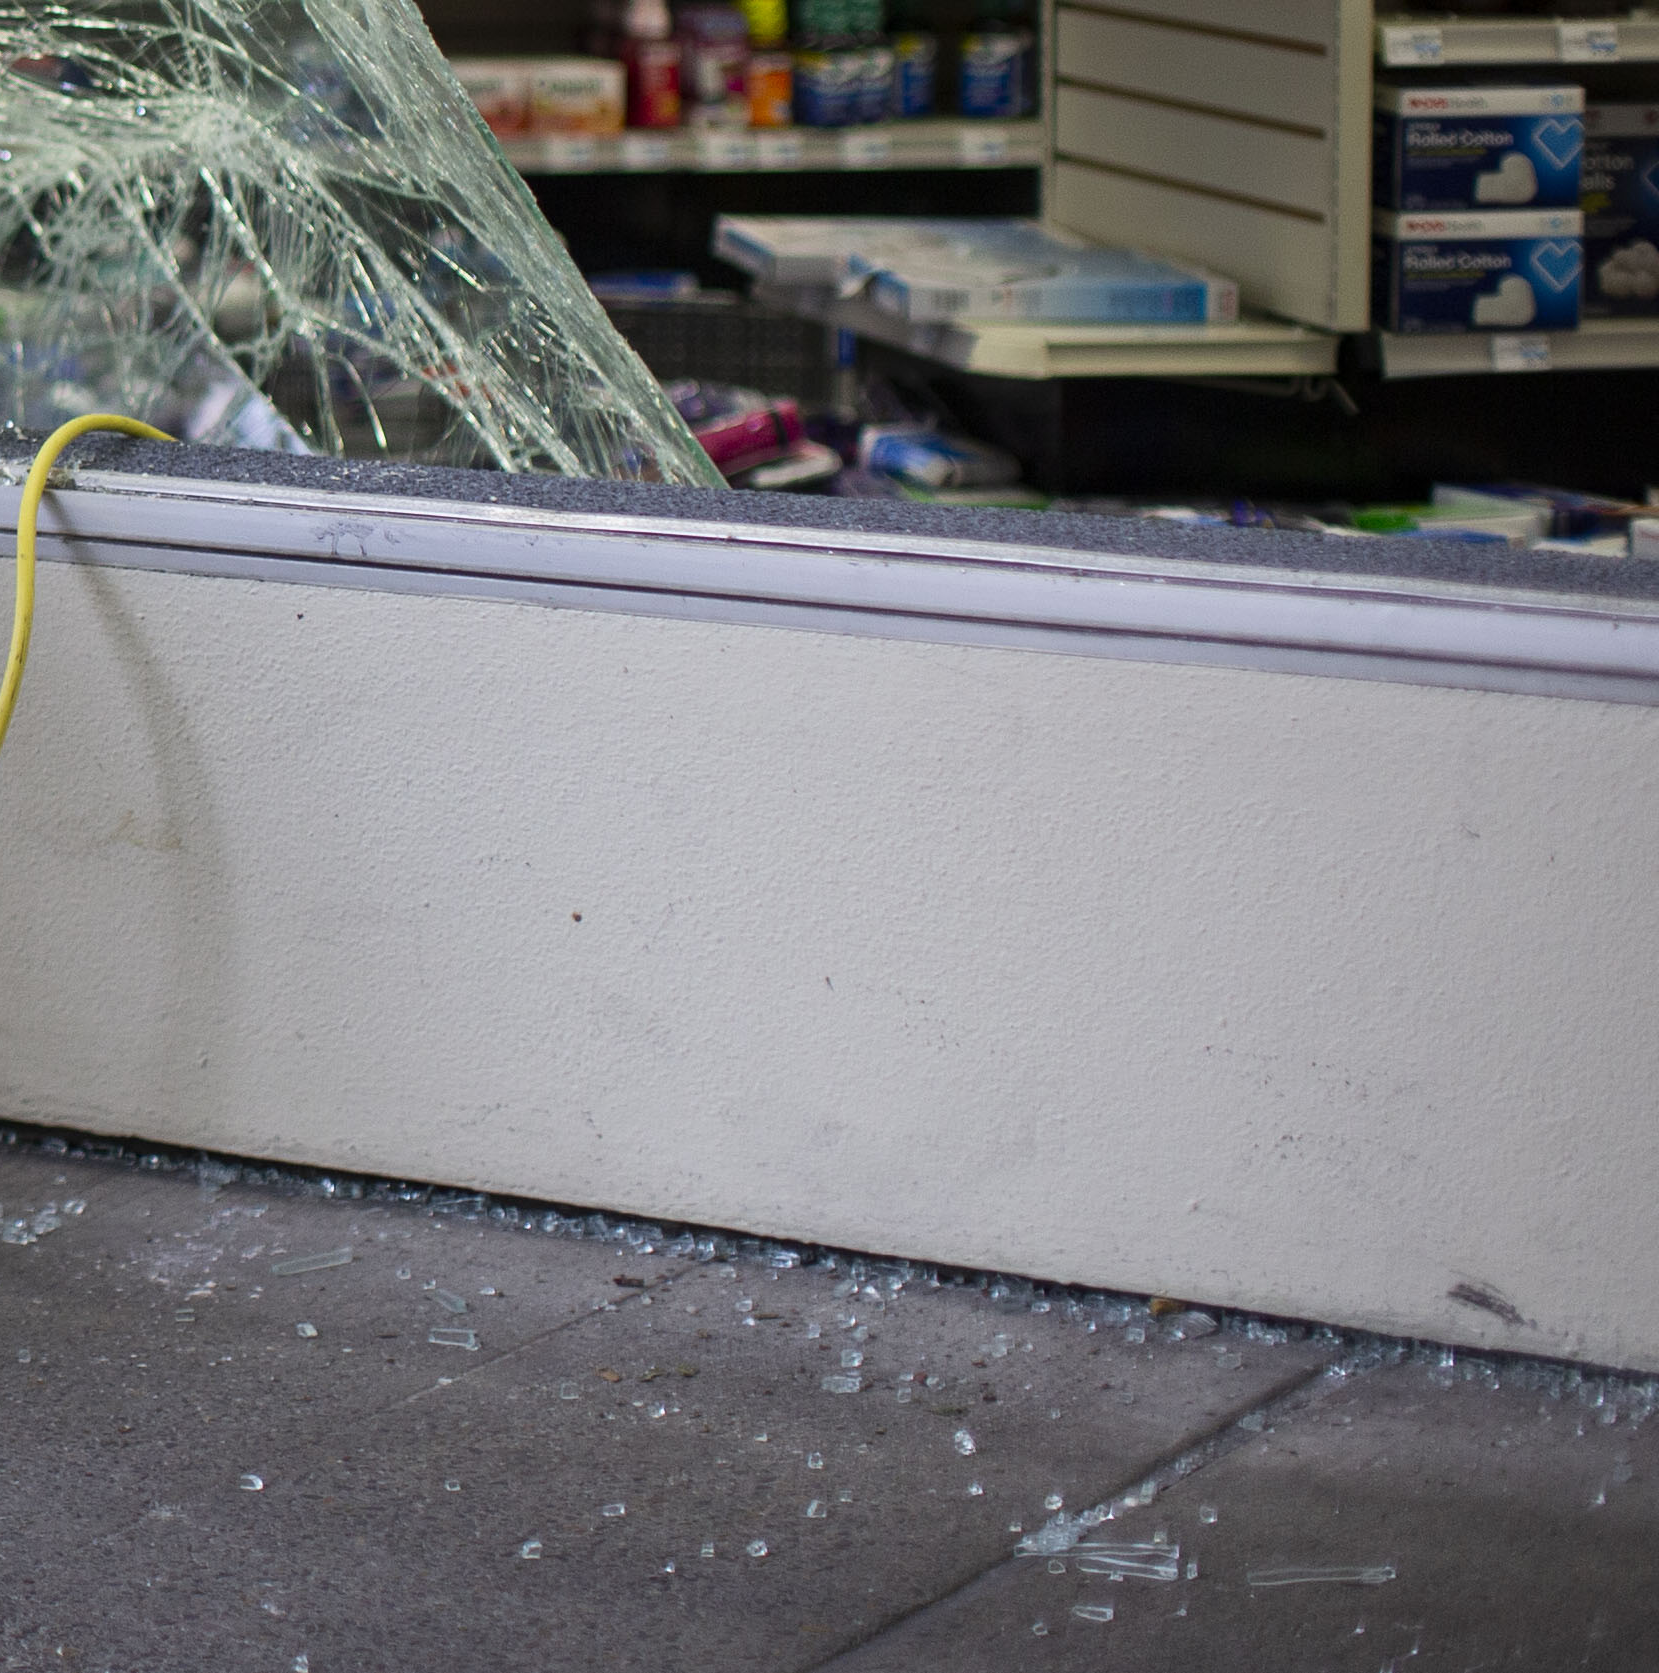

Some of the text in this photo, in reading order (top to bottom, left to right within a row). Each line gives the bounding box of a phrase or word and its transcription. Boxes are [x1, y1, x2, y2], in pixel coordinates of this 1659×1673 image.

[1407, 130, 1514, 146] Rolled Cotton
[1582, 154, 1634, 169] otton
[1581, 174, 1616, 190] alls
[1403, 254, 1512, 269] Rolled Cotton
